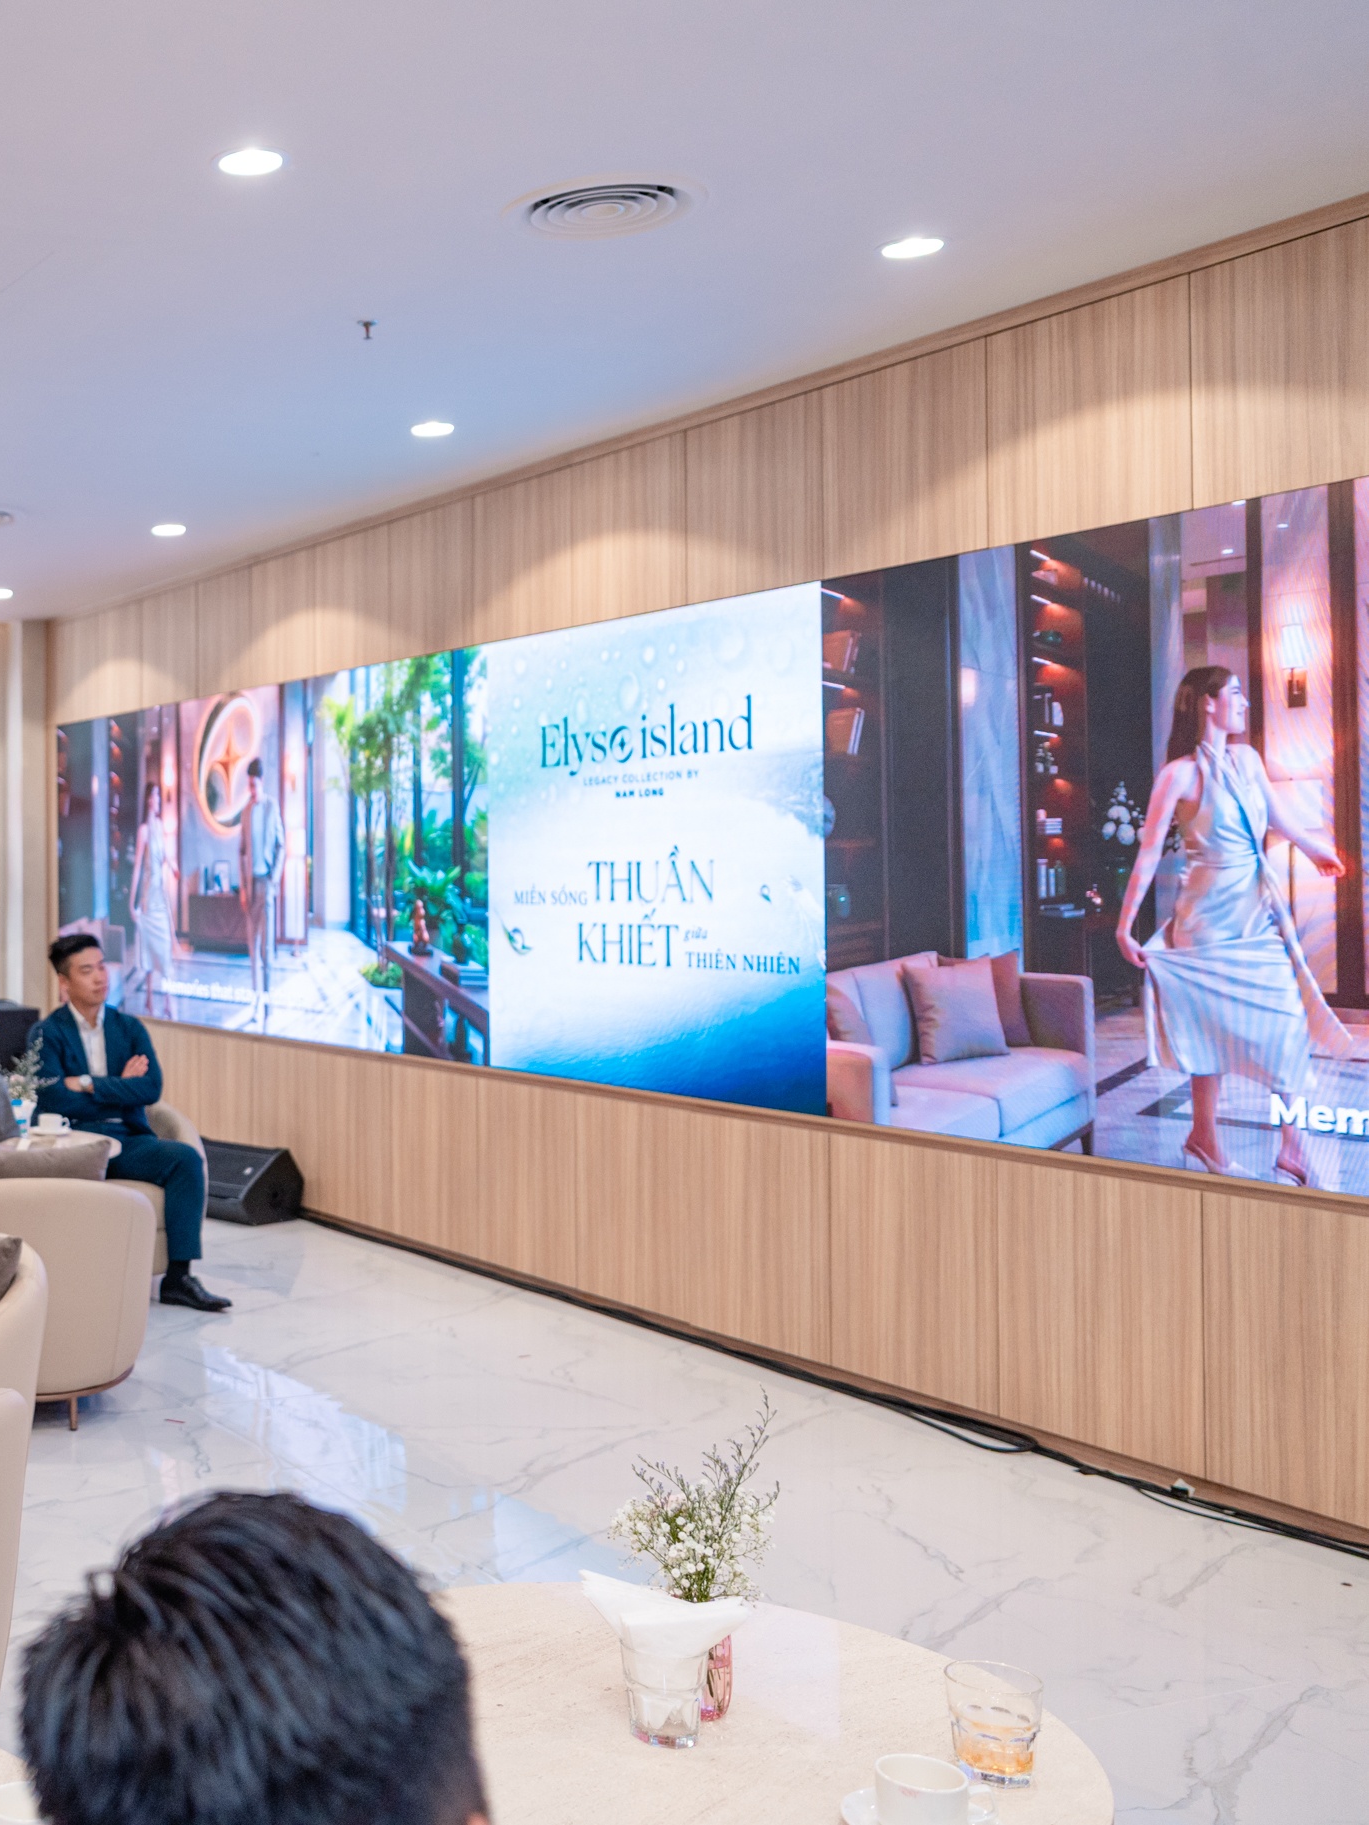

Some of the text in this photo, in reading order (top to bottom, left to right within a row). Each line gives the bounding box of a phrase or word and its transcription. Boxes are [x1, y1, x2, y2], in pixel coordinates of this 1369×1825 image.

[640, 694, 753, 759] island
[583, 769, 699, 786] LEGACY COLLECTION BY
[615, 787, 664, 798] NAM LONG
[587, 844, 715, 903] THUẦN
[578, 907, 680, 968] KHIẾT
[685, 948, 800, 975] THIÊN NHIÊN
